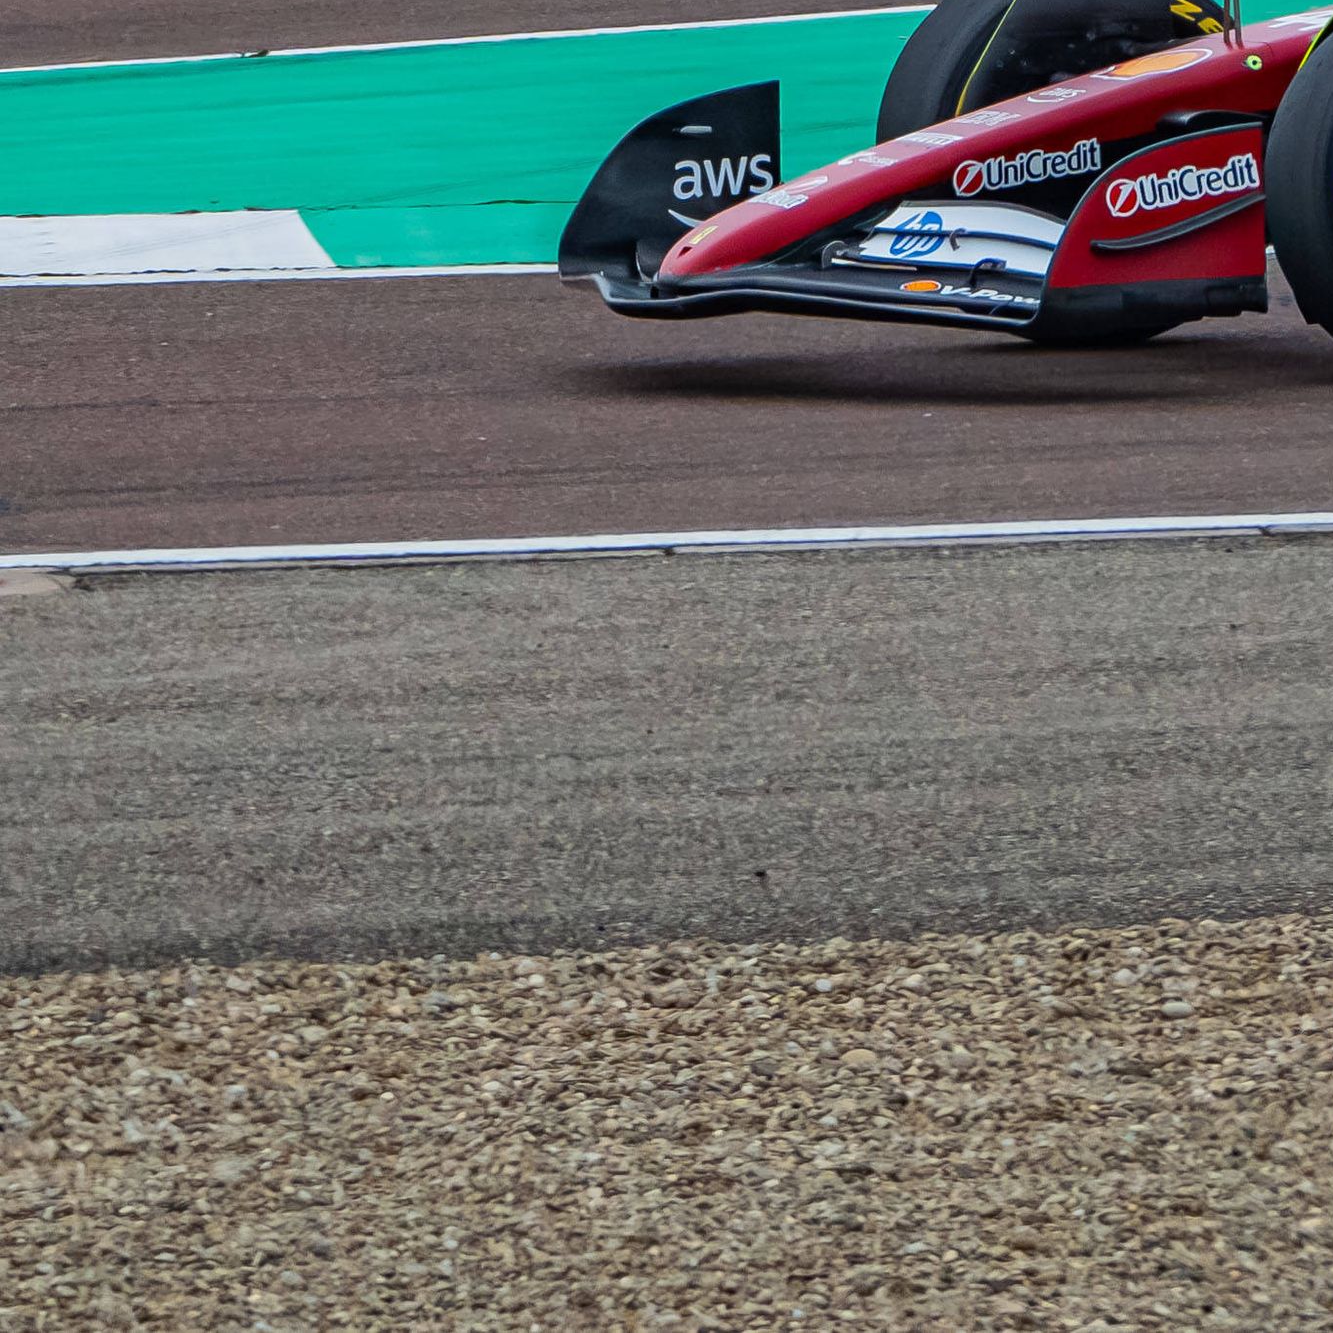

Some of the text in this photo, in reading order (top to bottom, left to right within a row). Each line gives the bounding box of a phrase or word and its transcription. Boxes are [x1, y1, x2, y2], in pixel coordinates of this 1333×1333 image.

[672, 153, 774, 200] aws
[985, 139, 1099, 189] UniCredit
[1137, 155, 1258, 208] UniCredit
[940, 285, 1041, 304] V-Pow
